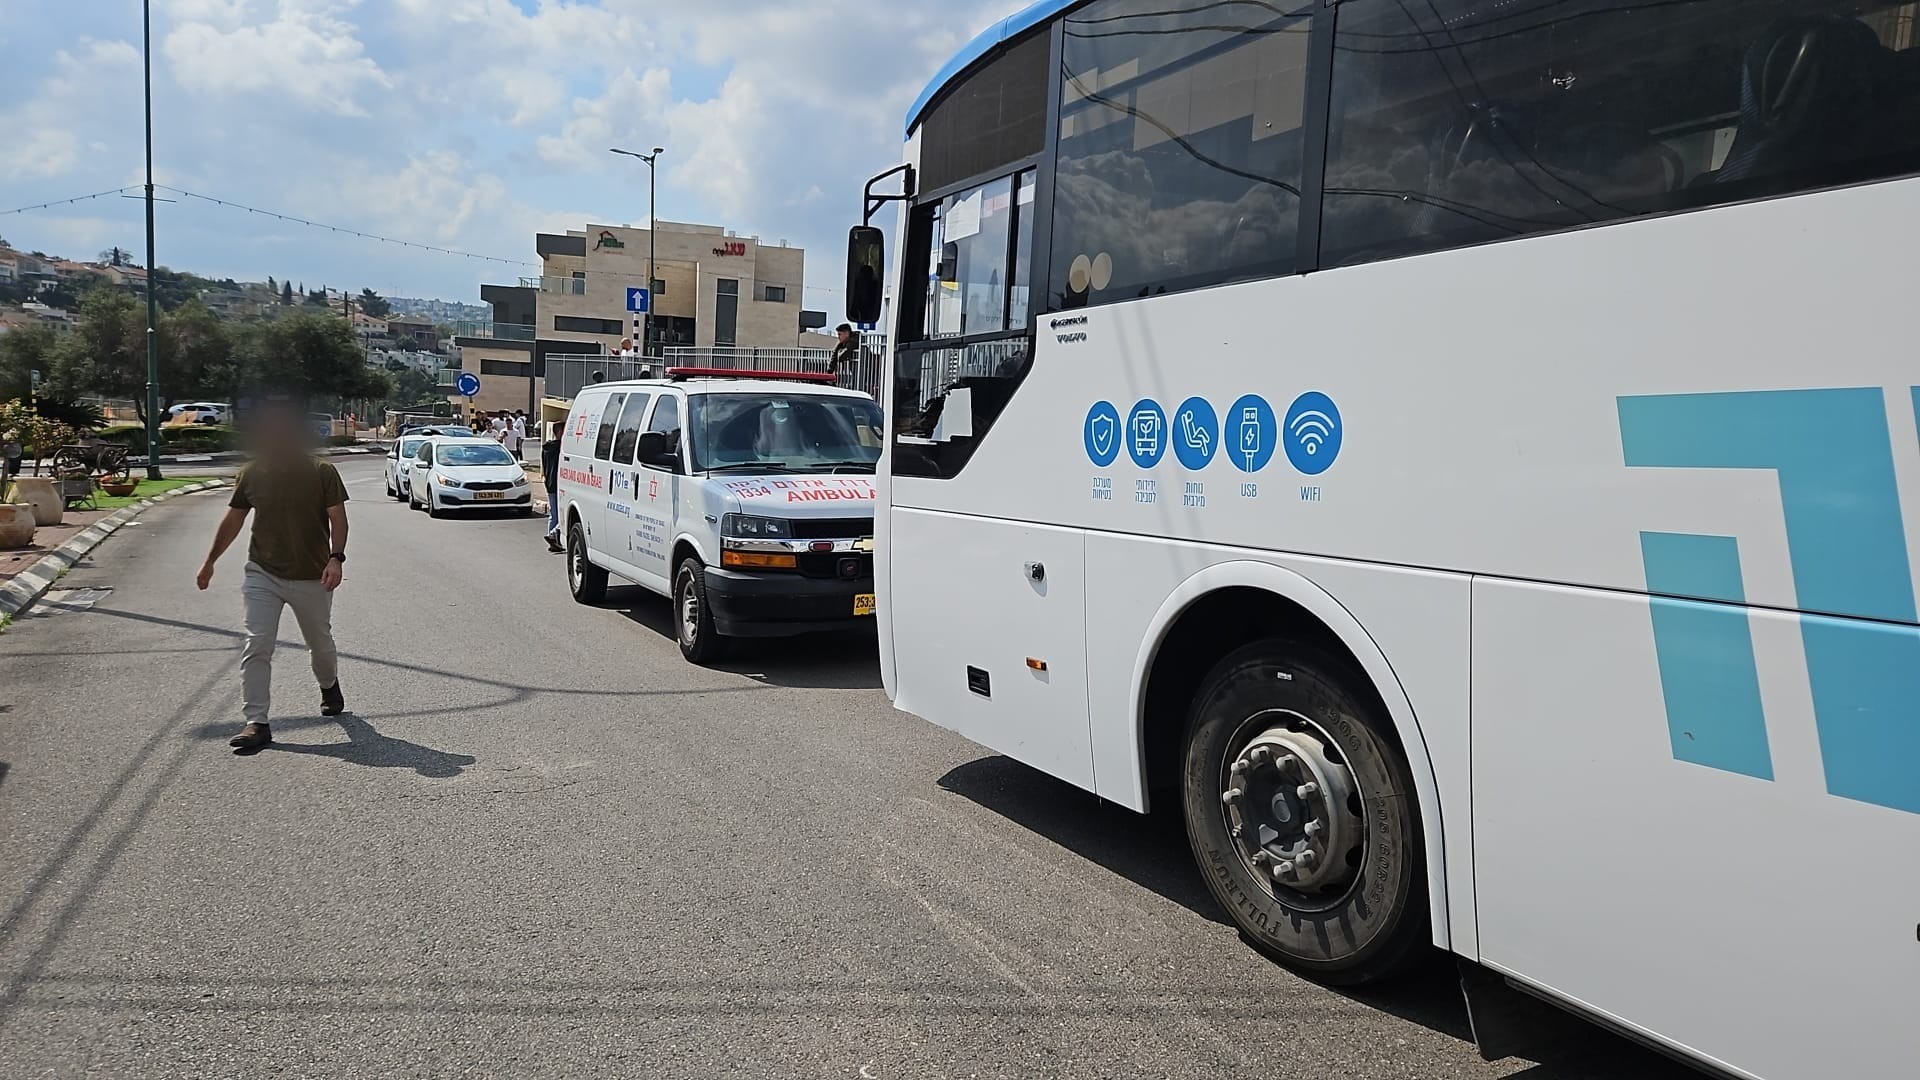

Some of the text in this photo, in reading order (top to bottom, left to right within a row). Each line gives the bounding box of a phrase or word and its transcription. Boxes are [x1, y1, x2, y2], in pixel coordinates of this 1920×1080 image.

[1056, 332, 1087, 343] VOLVO
[772, 479, 871, 489] דוד אדום
[1093, 477, 1112, 488] מערכת
[1136, 479, 1156, 490] ידידותי
[1185, 482, 1204, 494] נוחות
[736, 486, 771, 498] 1334
[1092, 489, 1112, 500] בטיחות
[1240, 483, 1257, 498] USB
[1300, 486, 1321, 501] WIFI
[1135, 491, 1157, 503] לסביבה
[1183, 494, 1205, 507] מירבית
[1208, 849, 1281, 937] FULLRUN
